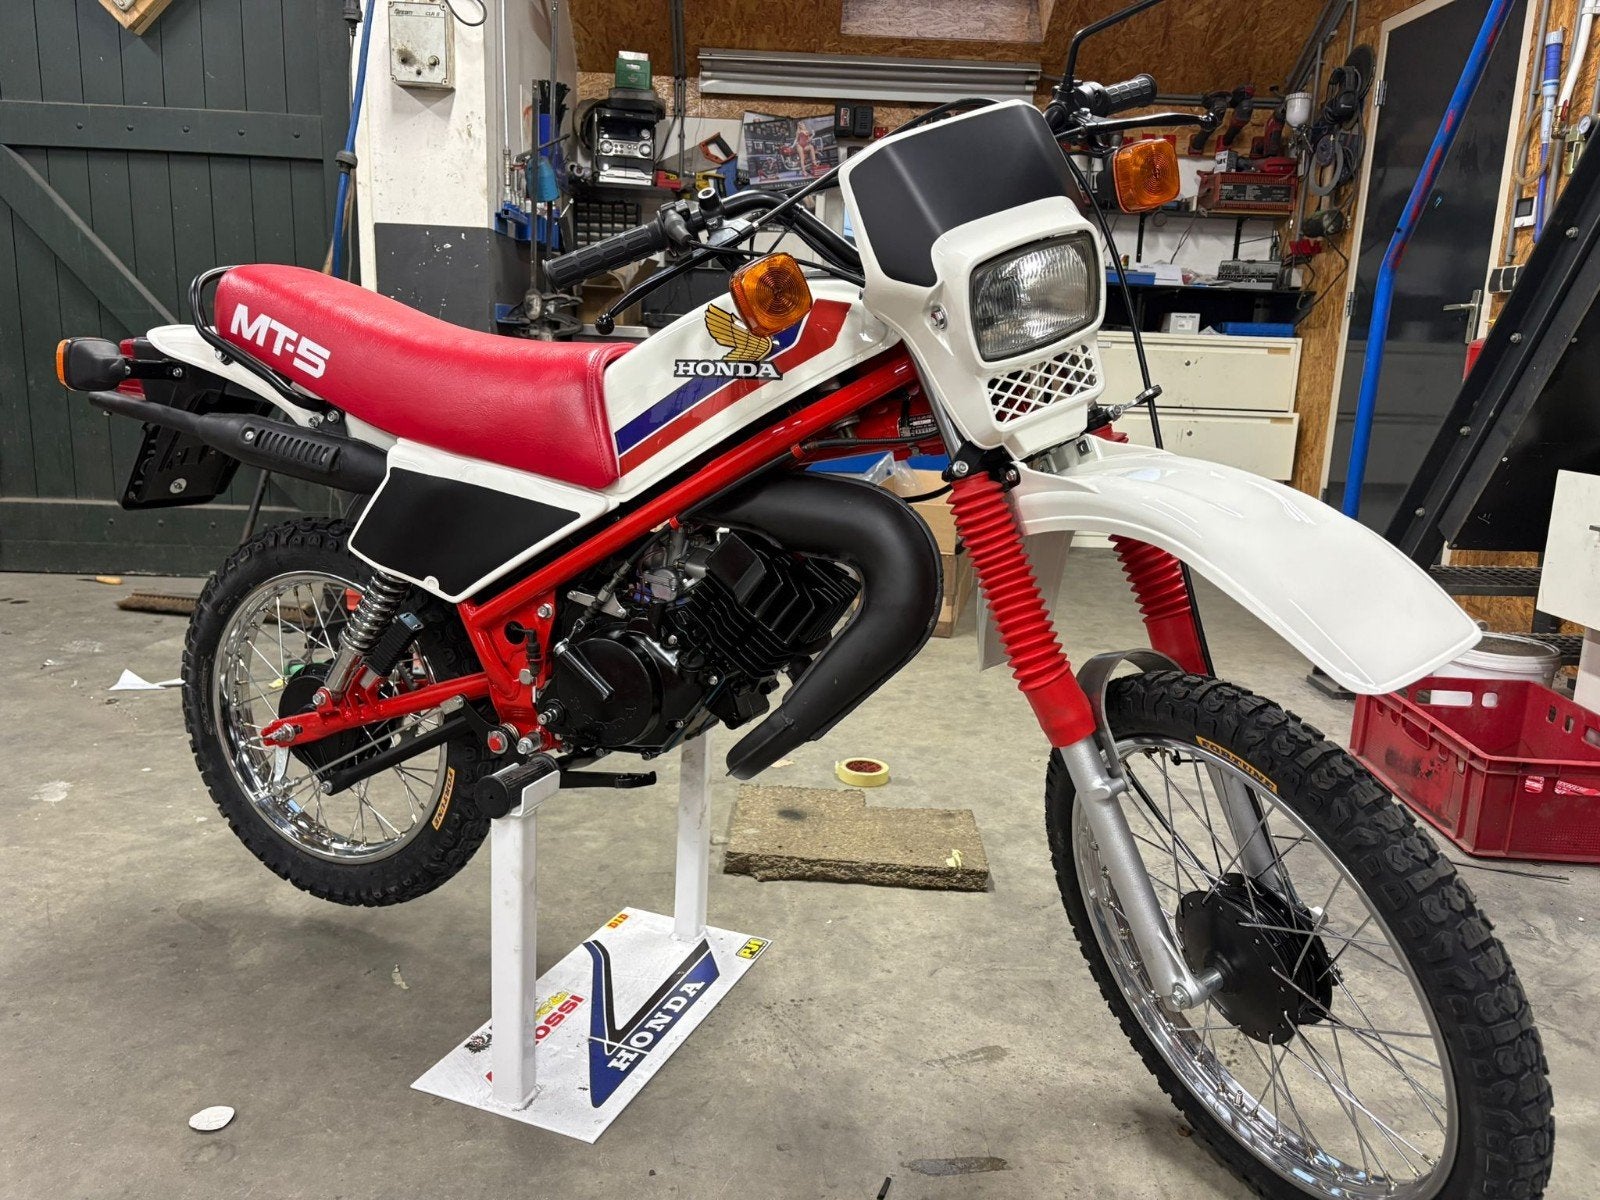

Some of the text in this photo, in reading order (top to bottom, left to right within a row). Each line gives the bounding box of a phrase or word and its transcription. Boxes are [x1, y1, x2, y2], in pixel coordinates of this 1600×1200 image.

[230, 302, 331, 379] MT-5
[675, 361, 780, 378] HONDA
[1200, 739, 1276, 791] FORTUNE
[434, 769, 454, 828] FORTUNE
[607, 912, 630, 929] DID
[534, 994, 585, 1046] OSSI
[606, 981, 706, 1072] HONDA
